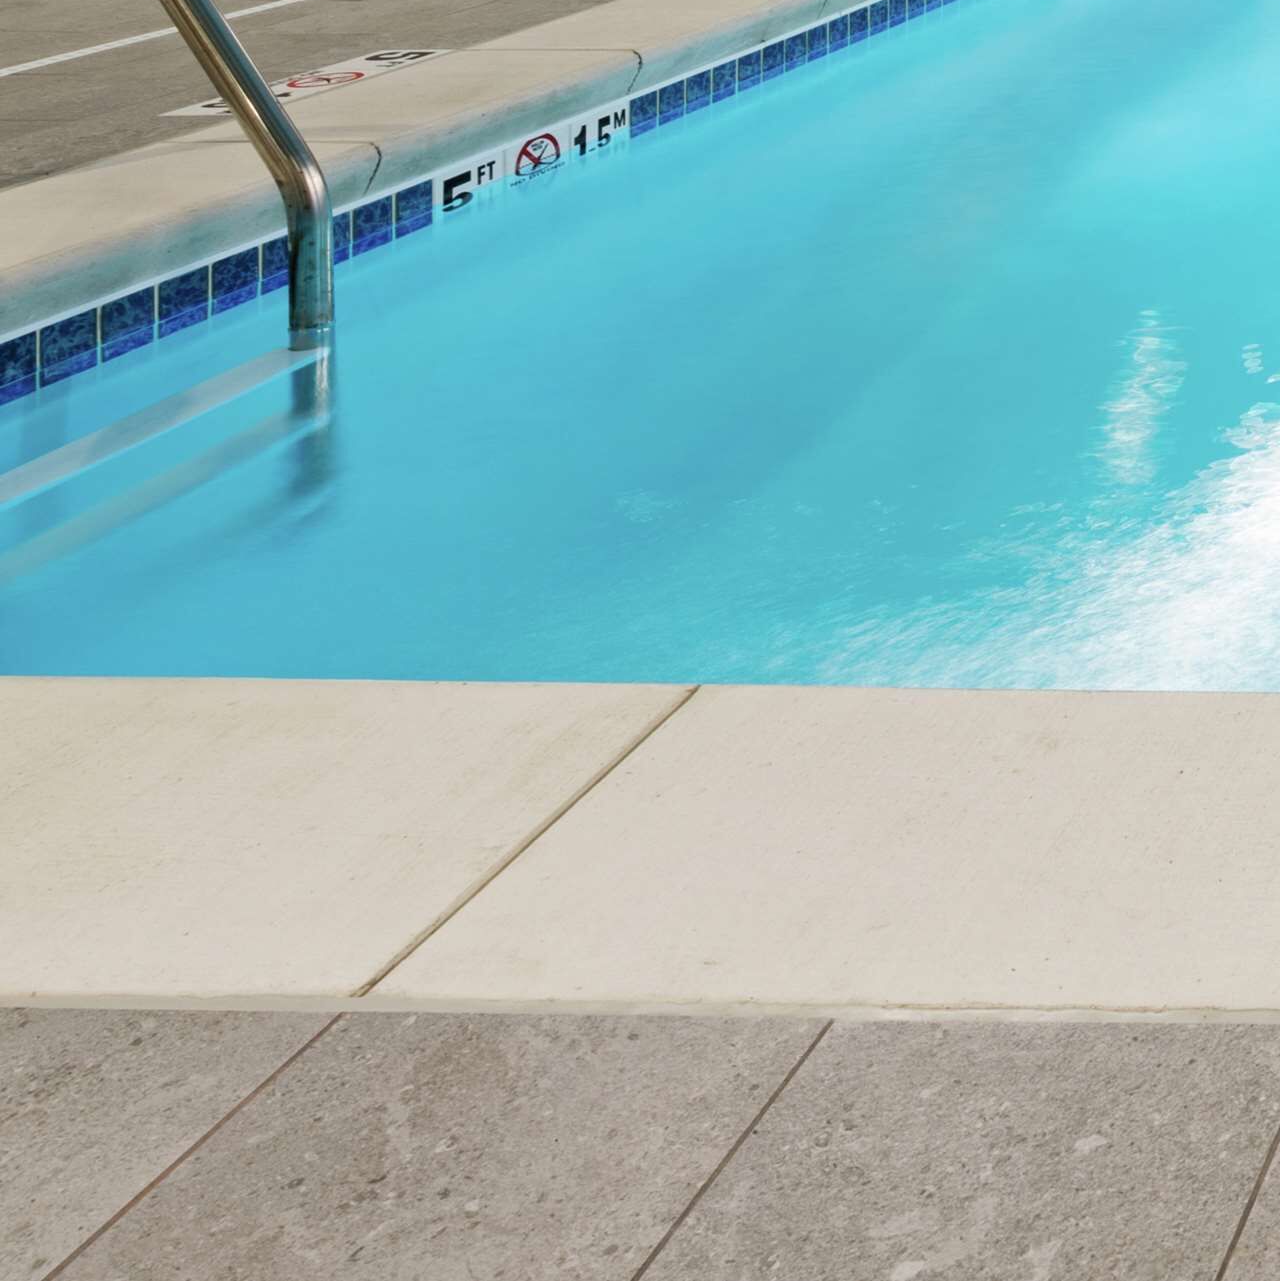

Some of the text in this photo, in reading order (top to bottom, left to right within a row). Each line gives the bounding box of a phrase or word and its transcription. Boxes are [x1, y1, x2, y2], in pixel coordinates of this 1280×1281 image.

[574, 109, 626, 156] 1.5 M
[442, 161, 496, 213] 5 FT
